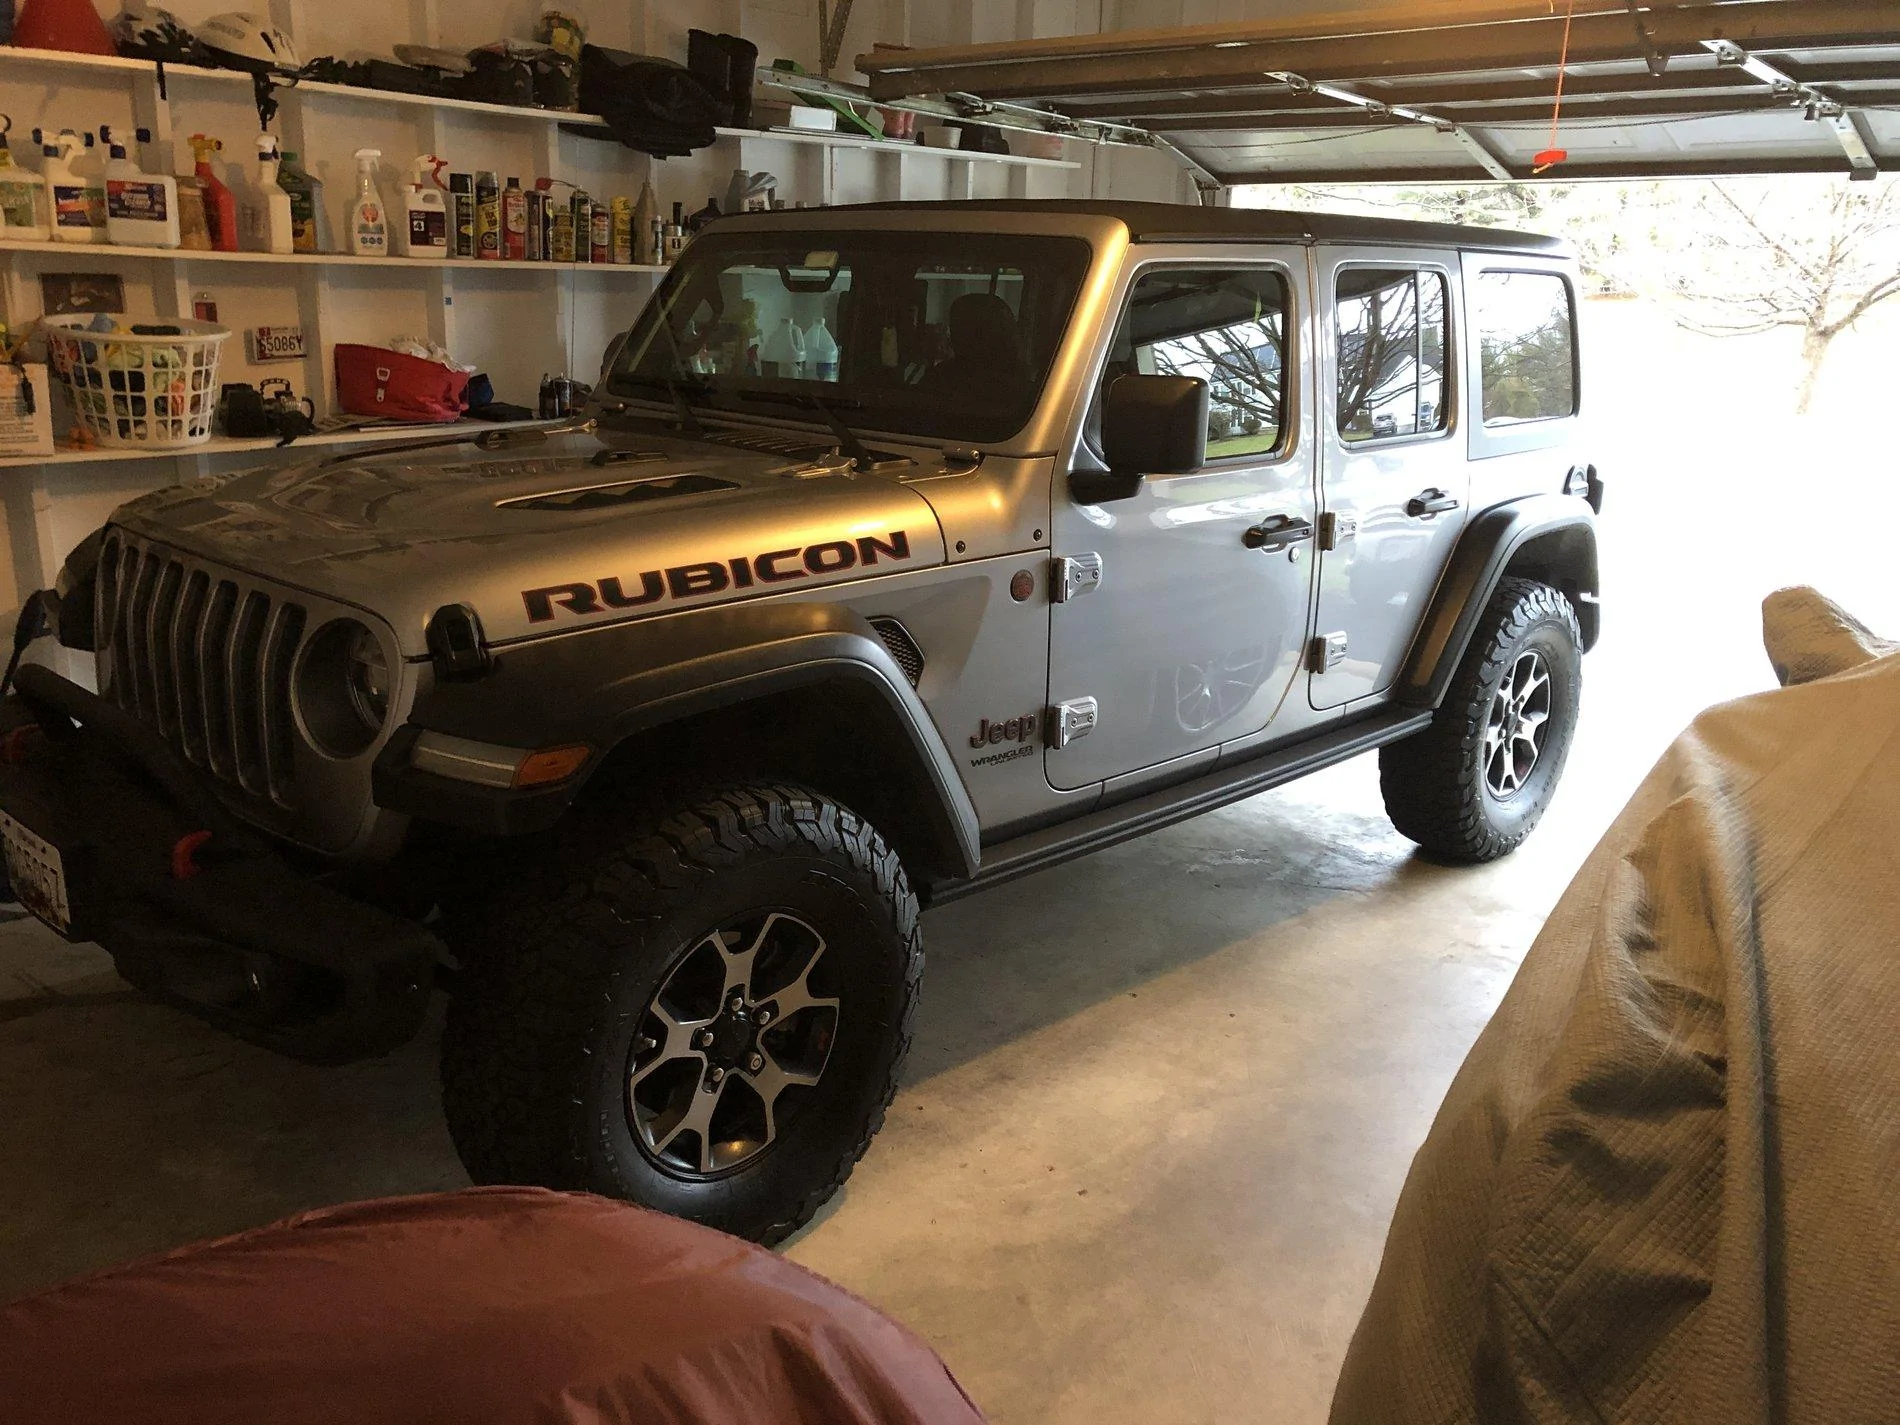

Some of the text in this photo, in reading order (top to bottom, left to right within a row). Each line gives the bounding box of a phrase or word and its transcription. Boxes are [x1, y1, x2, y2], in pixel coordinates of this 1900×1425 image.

[521, 530, 911, 624] RUBICON
[969, 714, 1035, 749] Jeep
[970, 746, 1034, 767] WRANGLER
